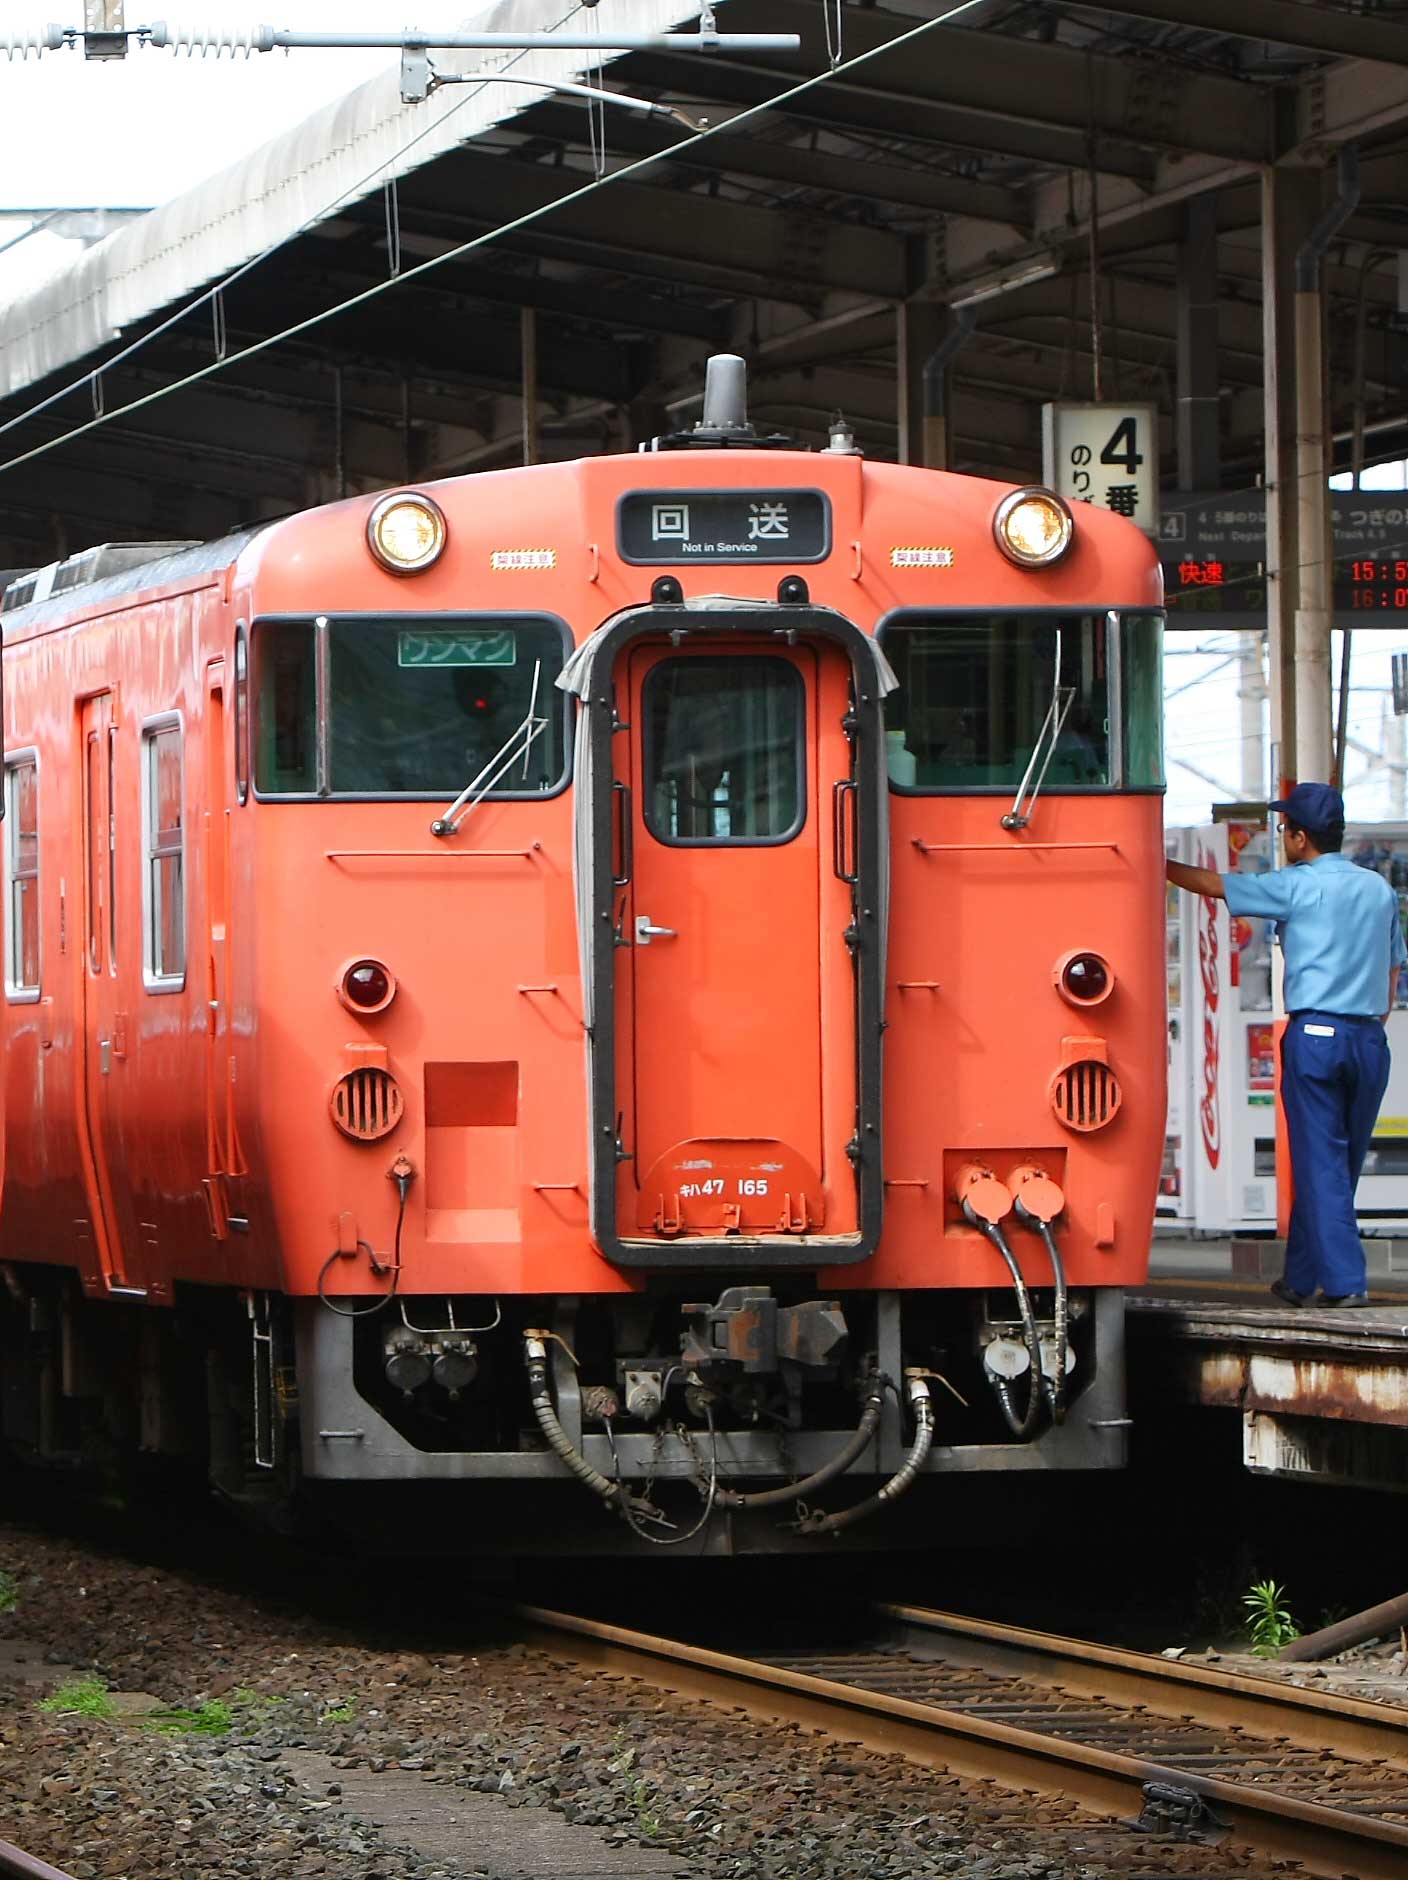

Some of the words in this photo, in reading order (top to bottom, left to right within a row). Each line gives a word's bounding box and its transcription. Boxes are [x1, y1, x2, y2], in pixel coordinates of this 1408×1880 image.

[682, 542, 702, 552] Not
[704, 542, 714, 552] in
[717, 542, 757, 552] Service
[1178, 561, 1224, 585] 快速
[1352, 561, 1408, 581] 15:5
[1353, 588, 1408, 608] 16:0
[738, 1180, 768, 1195] 165
